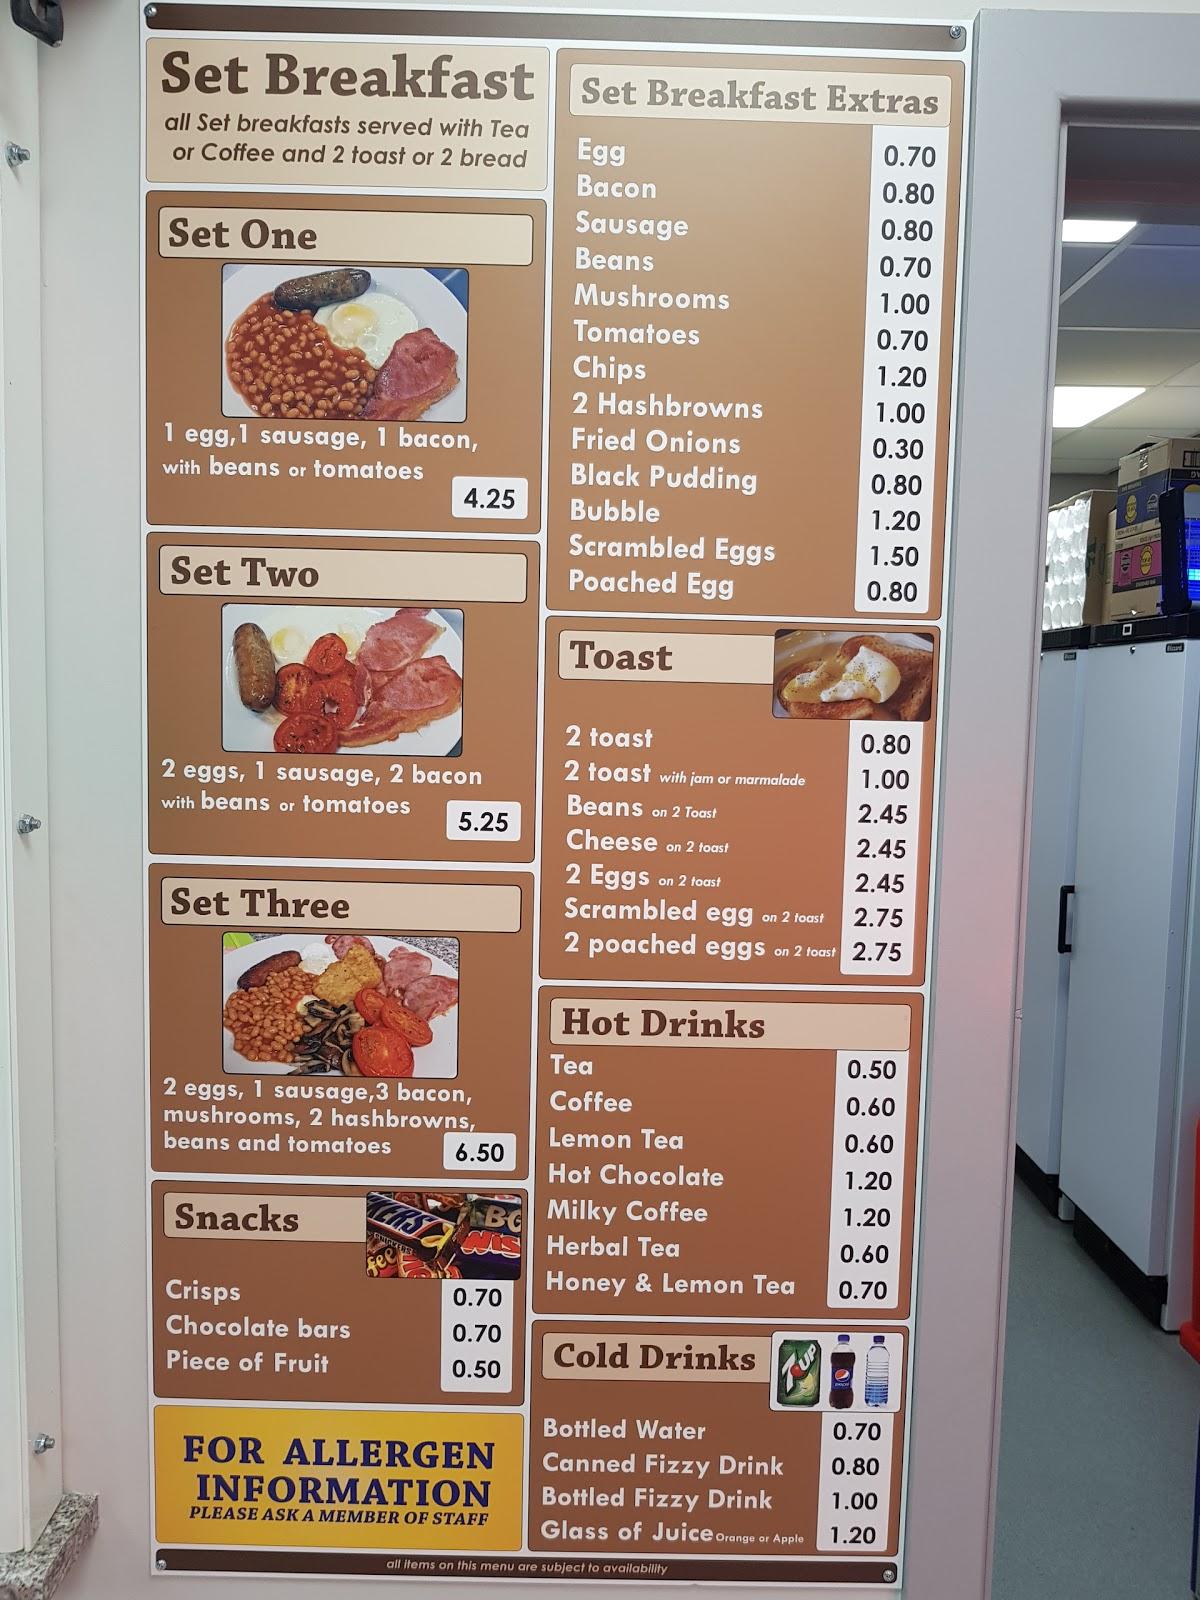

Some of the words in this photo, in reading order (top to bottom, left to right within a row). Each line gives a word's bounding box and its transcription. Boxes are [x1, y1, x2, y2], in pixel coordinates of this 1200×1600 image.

[162, 51, 248, 94] Set
[265, 53, 534, 100] Breakfast
[582, 78, 636, 105] Set
[647, 80, 816, 110] Breakfast
[827, 85, 938, 114] Extras
[165, 113, 190, 130] all
[197, 113, 230, 131] Set
[237, 114, 350, 133] breakfasts
[358, 118, 432, 135] served
[440, 119, 482, 136] with
[491, 120, 529, 138] Tea
[173, 147, 194, 160] or
[202, 143, 274, 161] Coffee
[283, 145, 325, 162] and
[333, 145, 344, 163] 2
[352, 146, 405, 164] toast
[413, 152, 434, 165] or
[441, 148, 452, 165] 2
[460, 148, 527, 167] bread
[579, 138, 625, 166] Egg
[885, 145, 935, 167] 0.70
[578, 174, 656, 198] Bacon
[883, 182, 934, 204] 0.80
[169, 218, 229, 248] Set
[241, 219, 317, 249] One
[576, 210, 688, 240] Sausage
[882, 219, 932, 241] 0.80
[575, 283, 729, 309] Mushrooms
[881, 293, 929, 314] 1.00
[574, 355, 645, 384] Chips
[878, 366, 926, 387] 1.20
[573, 392, 587, 413] 2
[599, 392, 762, 418] Hashbrowns
[573, 427, 635, 450] Fried
[646, 430, 740, 453] Onions
[873, 438, 923, 459] 0.30
[163, 459, 200, 474] with
[210, 455, 279, 476] beans
[289, 467, 306, 476] or
[314, 460, 423, 480] tomatoes
[572, 463, 639, 486] Black
[651, 465, 756, 495] Pudding
[464, 488, 514, 509] 4.25
[873, 510, 920, 531] 1.20
[570, 534, 704, 559] Scrambled
[716, 538, 775, 566] Eggs
[171, 556, 230, 585] Set
[241, 558, 318, 587] Two
[570, 641, 672, 670] Toast
[162, 759, 175, 777] 2
[184, 765, 244, 783] eggs,
[256, 761, 263, 779] 1
[277, 767, 380, 786] sausage,
[390, 764, 403, 782] 2
[413, 764, 481, 784] bacon
[565, 760, 579, 780] 2
[589, 763, 651, 782] toast
[660, 771, 686, 783] with
[690, 776, 713, 786] jam
[718, 776, 731, 784] or
[735, 773, 805, 785] marmalade
[863, 770, 909, 789] 1.00
[568, 794, 642, 816] Beans
[672, 806, 680, 817] 2
[686, 807, 716, 818] Toast
[858, 804, 907, 824] 2.45
[459, 812, 508, 832] 5.25
[171, 888, 229, 915] Set
[240, 888, 349, 918] Three
[565, 897, 696, 920] Scrambled
[707, 907, 752, 927] egg
[782, 911, 790, 922] 2
[795, 913, 824, 923] toast
[854, 908, 902, 927] 2.75
[565, 932, 578, 952] 2
[590, 933, 696, 958] poached
[706, 941, 765, 960] eggs
[794, 945, 802, 956] 2
[807, 947, 836, 957] toast
[853, 942, 901, 961] 2.75
[562, 1008, 629, 1035] Hot
[641, 1010, 764, 1038] Drinks
[551, 1054, 592, 1075] Tea
[848, 1060, 896, 1079] 0.50
[165, 1105, 300, 1128] mushrooms,
[310, 1108, 322, 1125] 2
[332, 1108, 475, 1132] hashbrowns,
[165, 1131, 229, 1150] beans
[238, 1134, 279, 1151] and
[288, 1136, 391, 1154] tomatoes
[456, 1143, 504, 1162] 6.50
[549, 1163, 591, 1183] Hot
[600, 1164, 723, 1186] Chocolate
[846, 1172, 892, 1190] 1.20
[176, 1203, 298, 1232] Snacks
[166, 1279, 240, 1305] Crisps
[547, 1271, 626, 1296] Honey
[636, 1273, 652, 1292] &
[663, 1273, 743, 1293] Lemon
[753, 1275, 794, 1294] Tea
[839, 1281, 887, 1299] 0.70
[454, 1288, 501, 1307] 0.70
[166, 1315, 288, 1337] Chocolate
[299, 1318, 350, 1338] bars
[167, 1350, 229, 1370] Piece
[239, 1352, 263, 1371] of
[275, 1353, 328, 1373] Fruit
[554, 1342, 629, 1368] Cold
[640, 1345, 755, 1370] Drinks
[453, 1360, 500, 1378] 0.50
[544, 1418, 626, 1438] Bottled
[636, 1420, 705, 1439] Water
[834, 1423, 881, 1440] 0.70
[184, 1436, 264, 1464] FOR
[283, 1439, 494, 1469] ALLERGEN
[197, 1474, 490, 1507] INFORMATION
[543, 1487, 624, 1506] Bottled
[635, 1488, 699, 1512] Fizzy
[709, 1489, 771, 1509] Drink
[833, 1493, 877, 1510] 1.00
[190, 1506, 258, 1520] PLEASE
[261, 1508, 299, 1521] ASK
[302, 1509, 314, 1521] A
[319, 1510, 399, 1523] MEMBER
[405, 1512, 428, 1524] OF
[433, 1512, 488, 1525] STAFF
[541, 1520, 608, 1539] Glass
[619, 1522, 642, 1540] of
[653, 1522, 713, 1541] Juice
[716, 1533, 755, 1544] Orange
[773, 1534, 803, 1544] Apple
[831, 1527, 875, 1544] 1.20
[387, 1560, 401, 1568] all
[404, 1560, 435, 1569] items
[458, 1561, 476, 1570] this
[481, 1563, 514, 1571] menu
[542, 1562, 585, 1574] subject
[588, 1563, 599, 1572] to
[603, 1563, 667, 1575] availability
